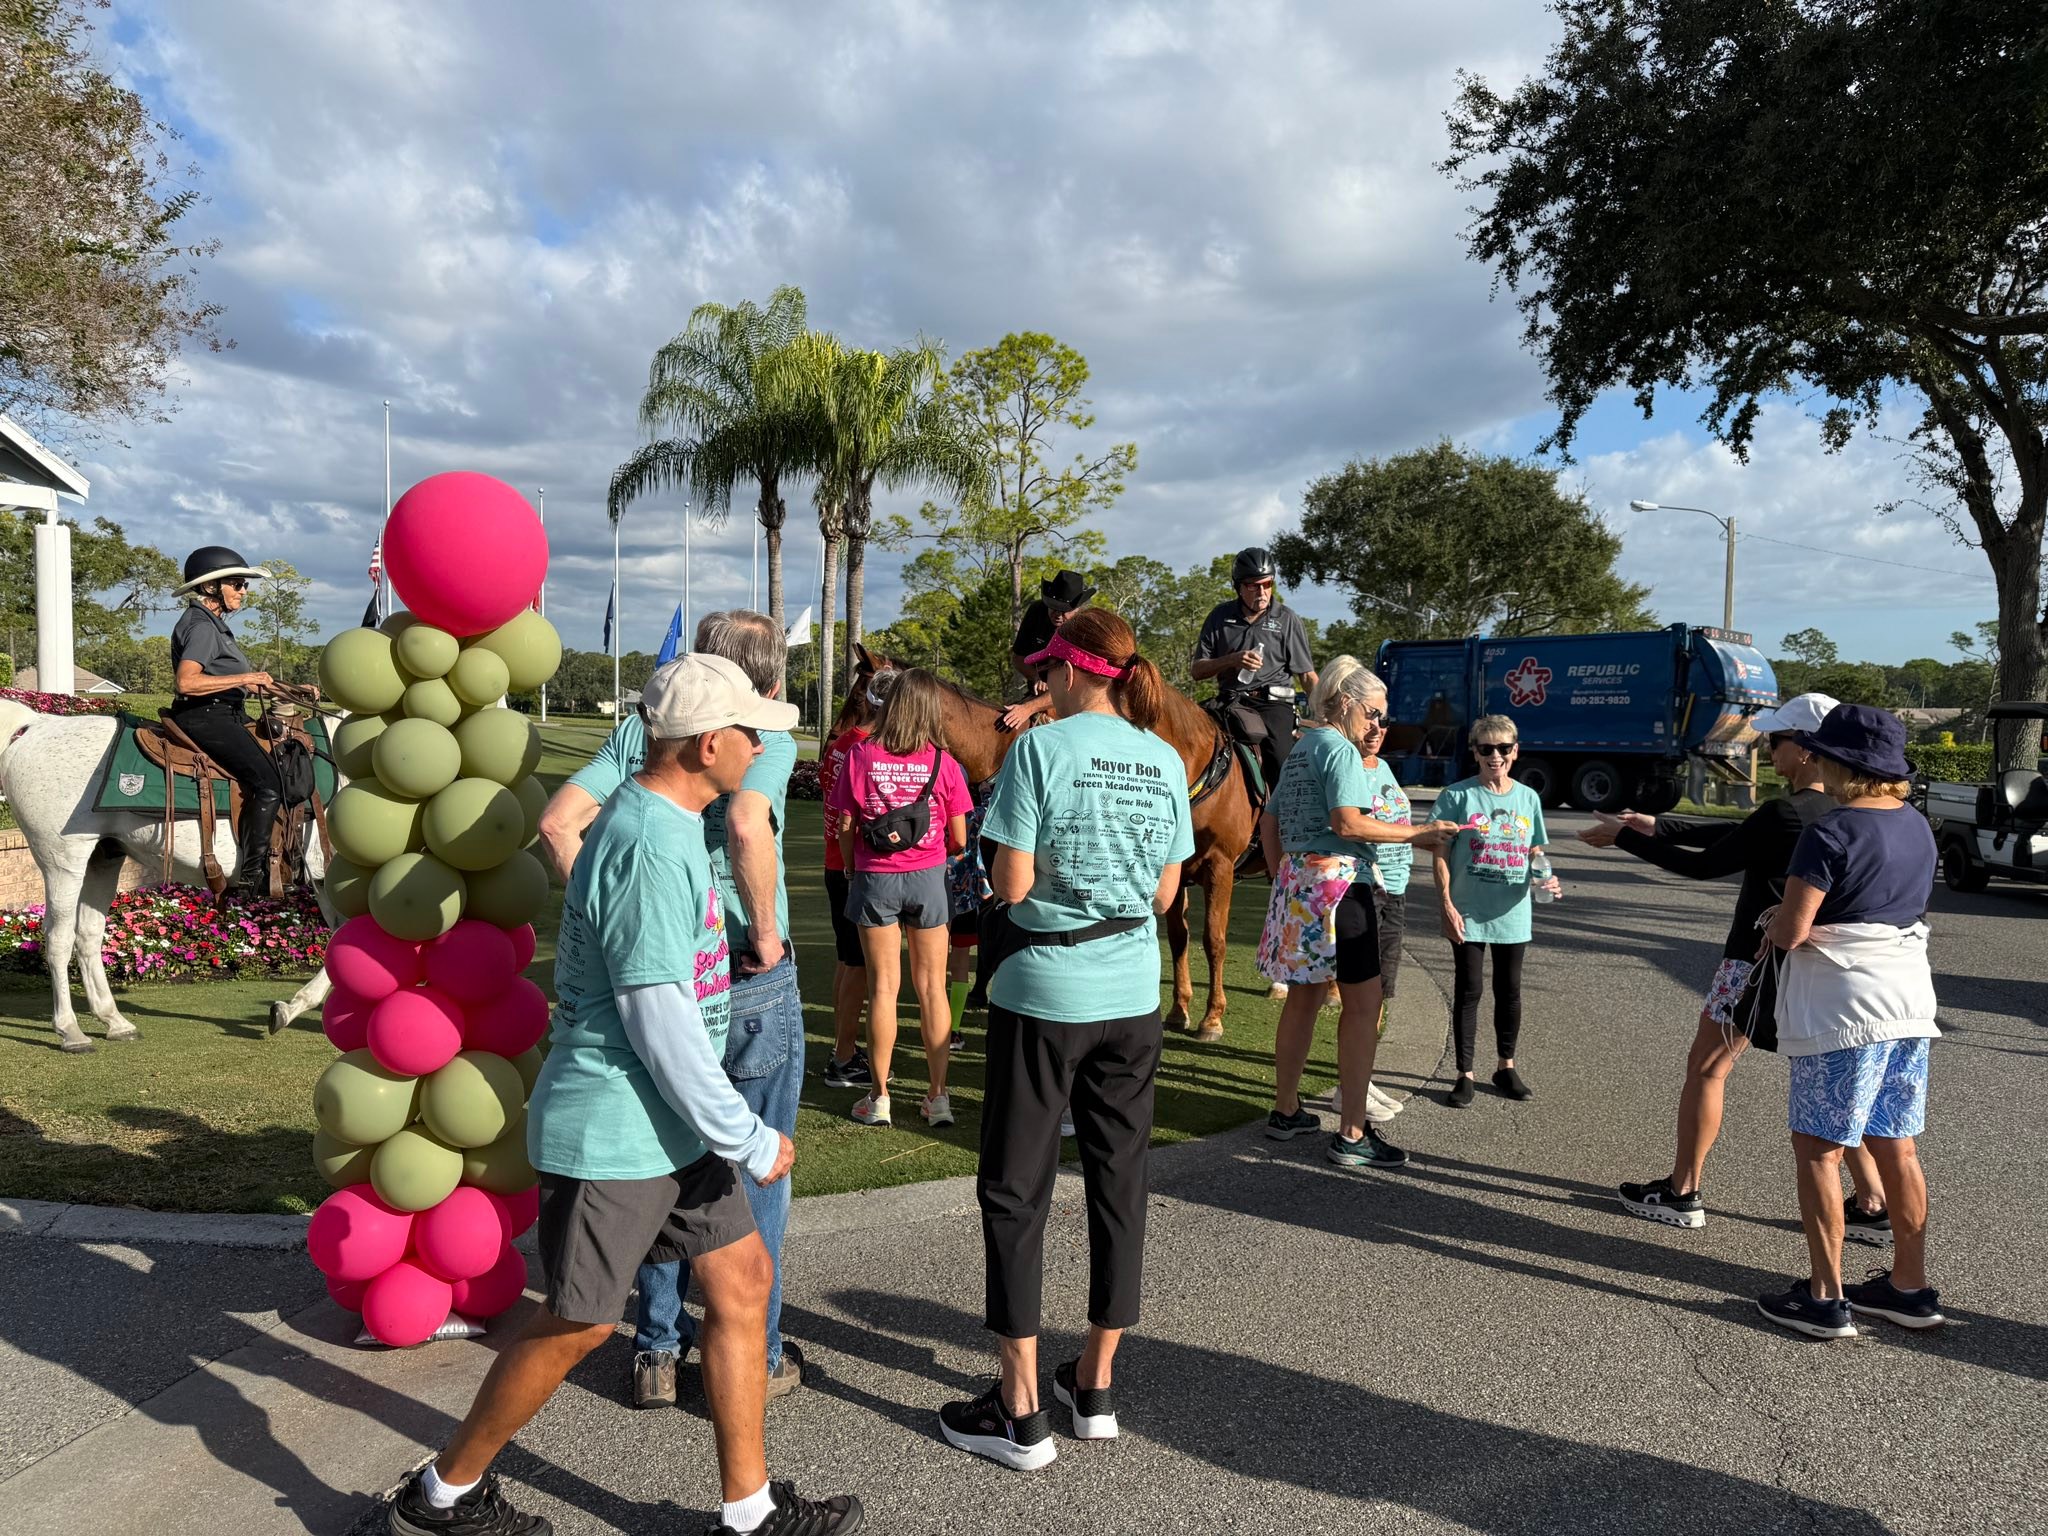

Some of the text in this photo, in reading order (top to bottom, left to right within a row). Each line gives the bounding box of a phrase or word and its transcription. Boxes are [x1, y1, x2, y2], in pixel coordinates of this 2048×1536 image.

[1484, 648, 1506, 656] 4053
[1567, 664, 1640, 677] REPUBLIC
[1582, 676, 1623, 685] SERVICES
[1570, 696, 1631, 705] 800-282-9820
[872, 761, 928, 773] Mayor Bob
[1091, 758, 1162, 778] Mayor Bob
[1073, 780, 1103, 789] Green
[1105, 781, 1143, 793] Meadow
[1139, 778, 1169, 788] SPONSORS
[1116, 797, 1153, 809] Gene Webb
[705, 1003, 723, 1016] PINES
